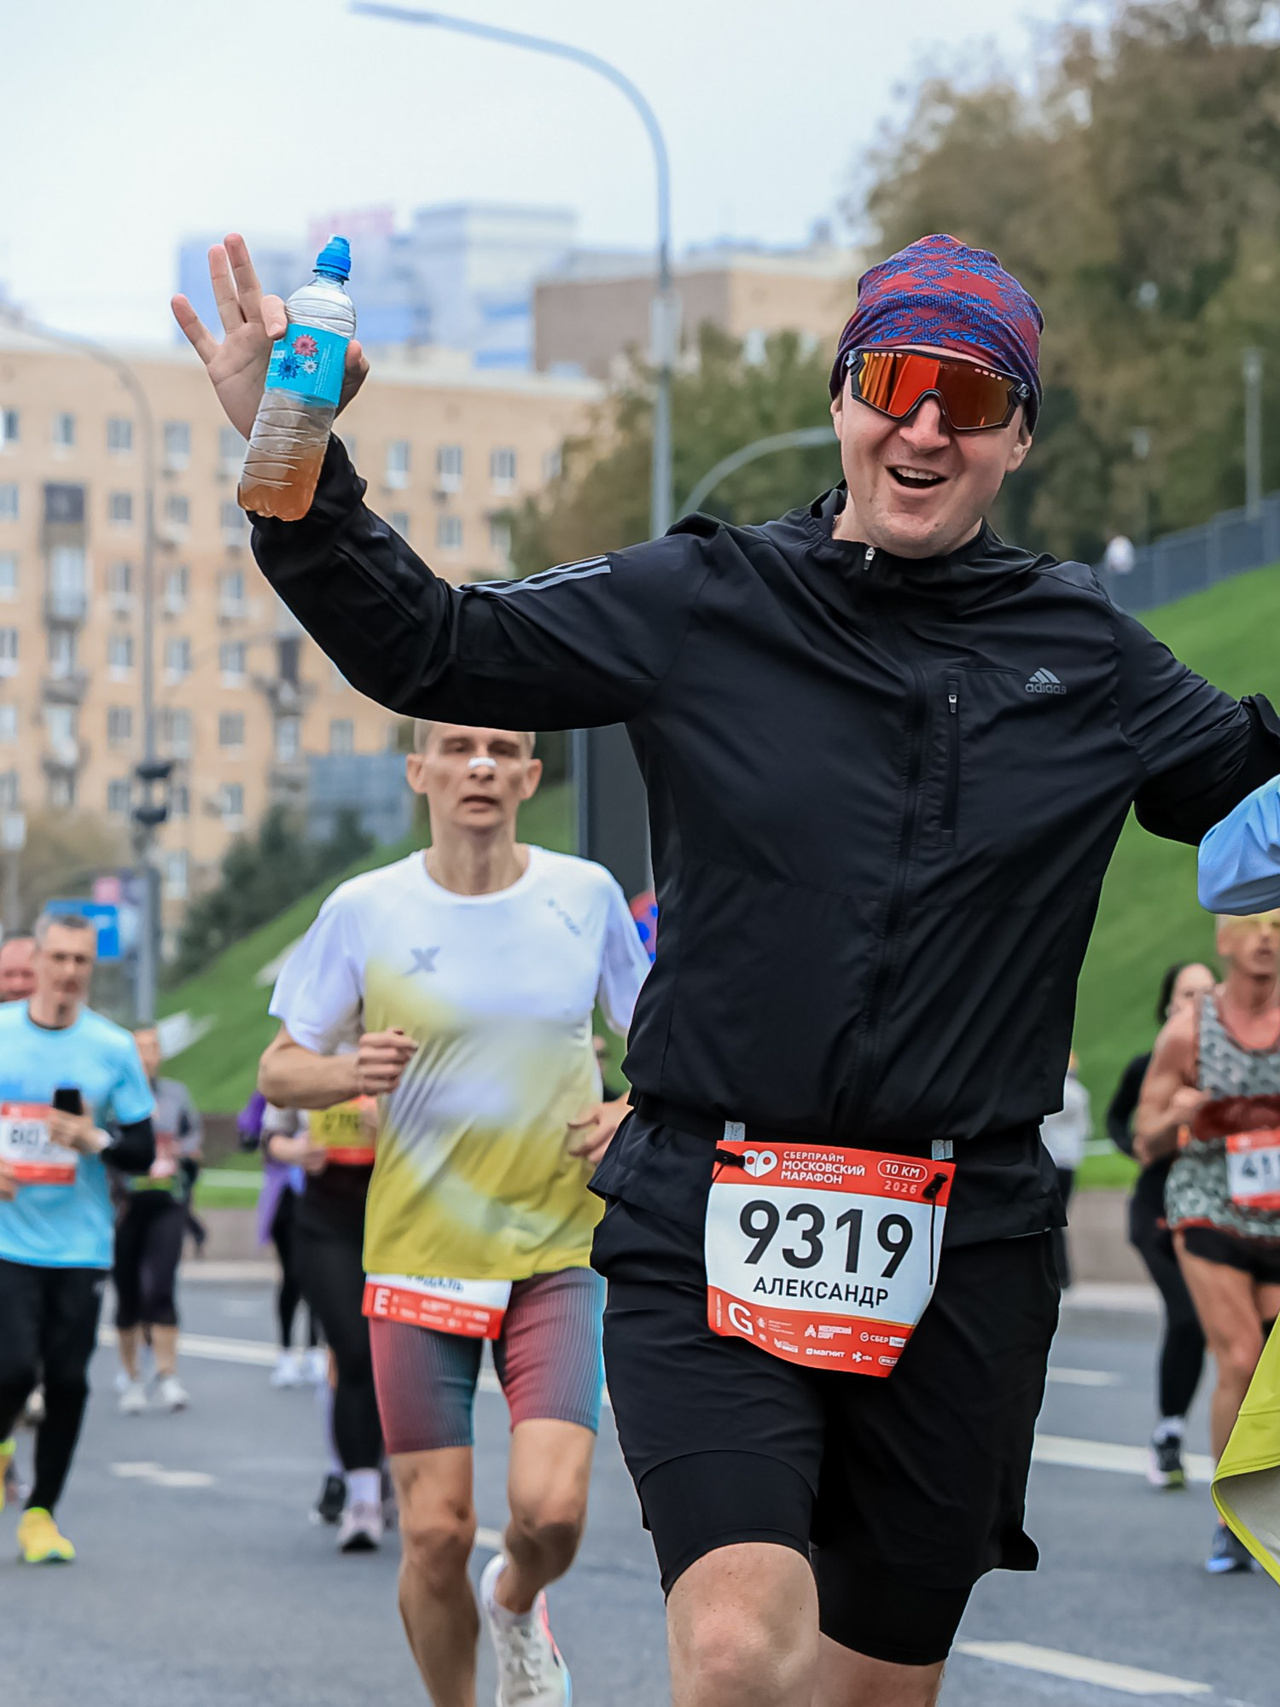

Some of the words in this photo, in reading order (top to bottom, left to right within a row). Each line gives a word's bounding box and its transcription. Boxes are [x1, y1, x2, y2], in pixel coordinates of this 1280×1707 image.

[1025, 681, 1067, 695] adidas
[783, 1151, 845, 1163] СБЕРПРАЙМ
[782, 1161, 865, 1177] МОСКОВСКИЙ
[885, 1164, 899, 1175] 10
[901, 1166, 920, 1178] КМ
[780, 1171, 843, 1184] МАРАФОН
[884, 1181, 918, 1194] 2026
[739, 1199, 913, 1279] 9319
[753, 1276, 889, 1309] АЛЕКСАНДР
[374, 1288, 391, 1315] E
[728, 1302, 754, 1336] G
